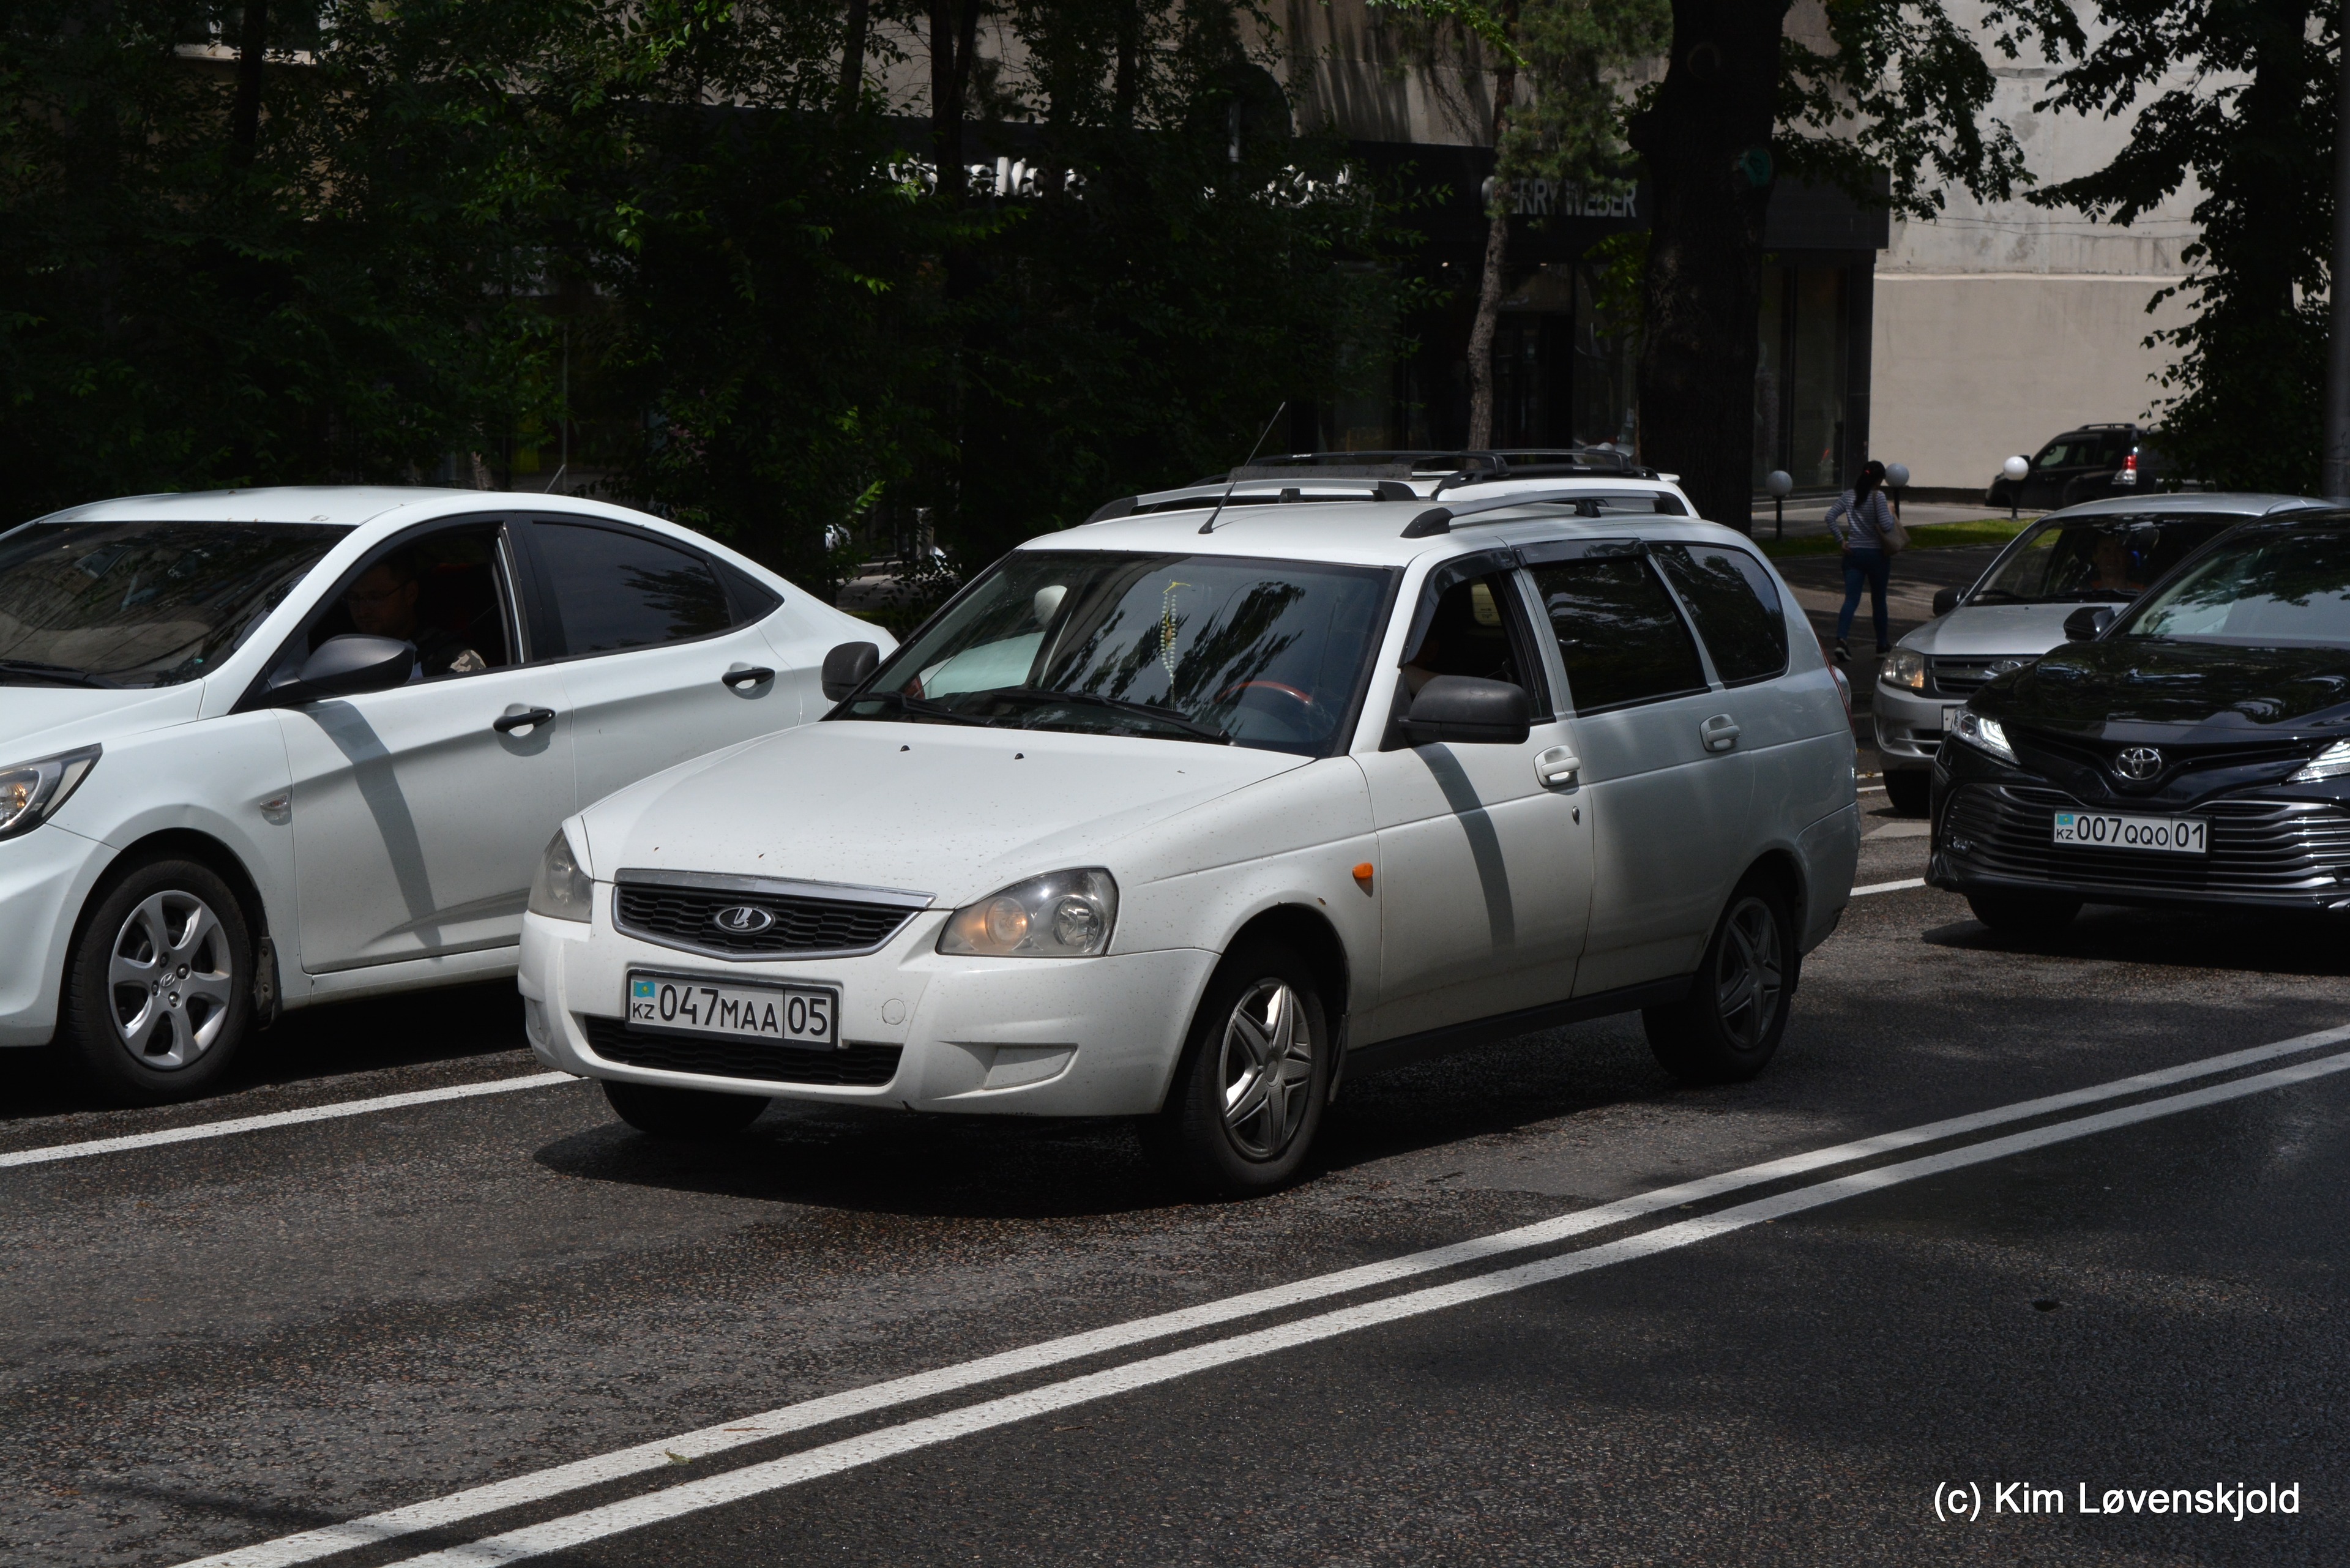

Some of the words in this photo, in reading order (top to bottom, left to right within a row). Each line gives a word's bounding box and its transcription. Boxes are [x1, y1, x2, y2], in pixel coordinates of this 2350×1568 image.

[2056, 829, 2073, 840] KZ
[2175, 823, 2204, 849] 01
[632, 1002, 655, 1020] KZ
[788, 996, 827, 1036] 05
